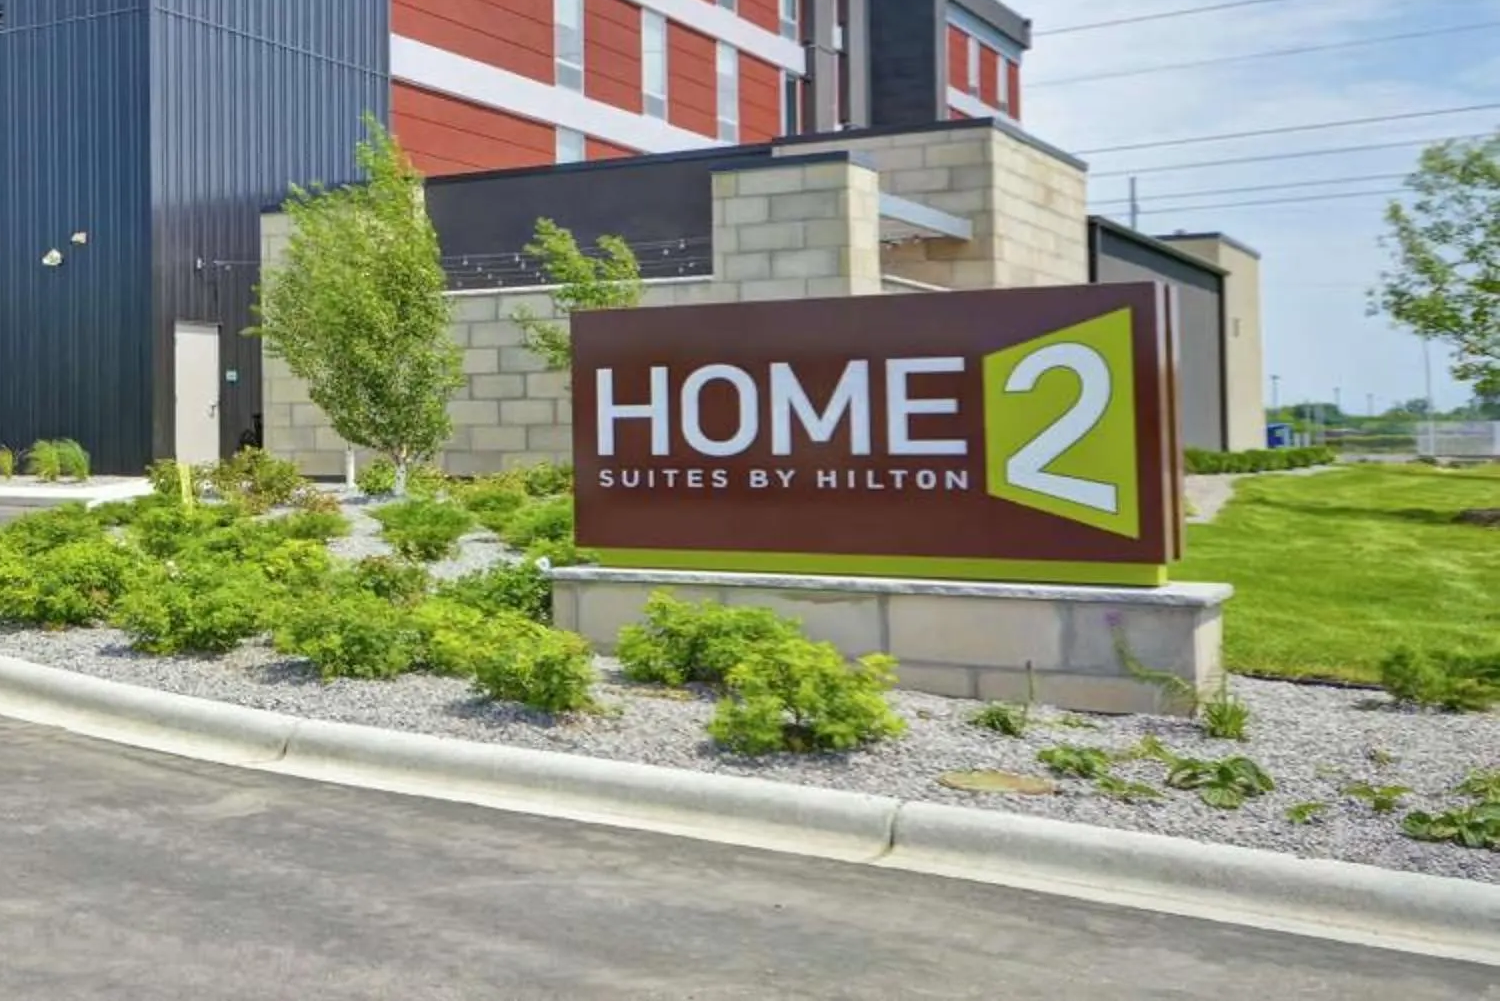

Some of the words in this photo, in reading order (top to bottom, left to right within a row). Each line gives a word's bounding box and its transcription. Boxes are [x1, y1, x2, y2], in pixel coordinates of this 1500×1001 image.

[595, 356, 967, 457] HOME
[1003, 341, 1119, 515] 2
[599, 469, 729, 489] SUITES
[749, 469, 797, 489] BY
[816, 470, 969, 491] HILTON
